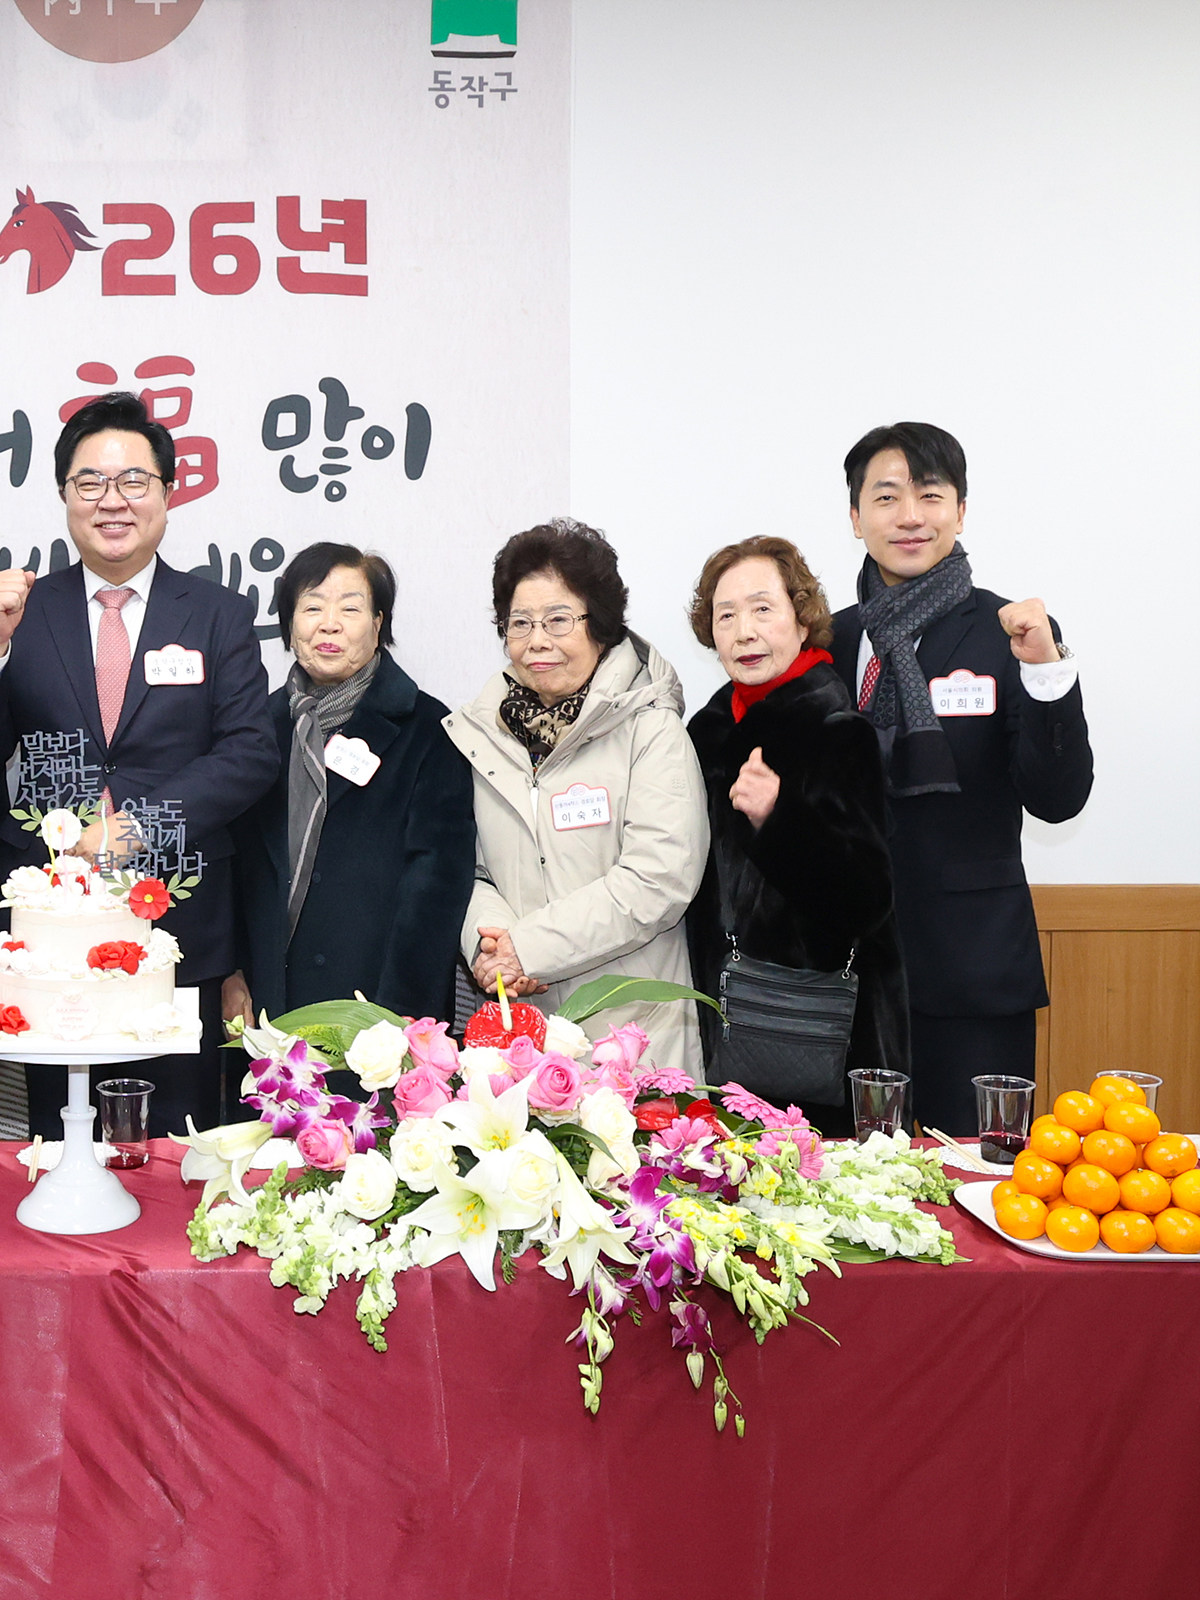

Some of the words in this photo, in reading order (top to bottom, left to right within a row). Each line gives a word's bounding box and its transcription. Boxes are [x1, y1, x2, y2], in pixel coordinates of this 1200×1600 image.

[428, 70, 518, 109] 동작구
[262, 377, 432, 502] 많이
[940, 697, 984, 709] 이희원
[22, 728, 89, 759] 말보다
[15, 781, 103, 812] 사당2동
[116, 797, 186, 826] 오늘도
[561, 807, 602, 823] 이숙자
[93, 850, 208, 881] 달려갑니다
